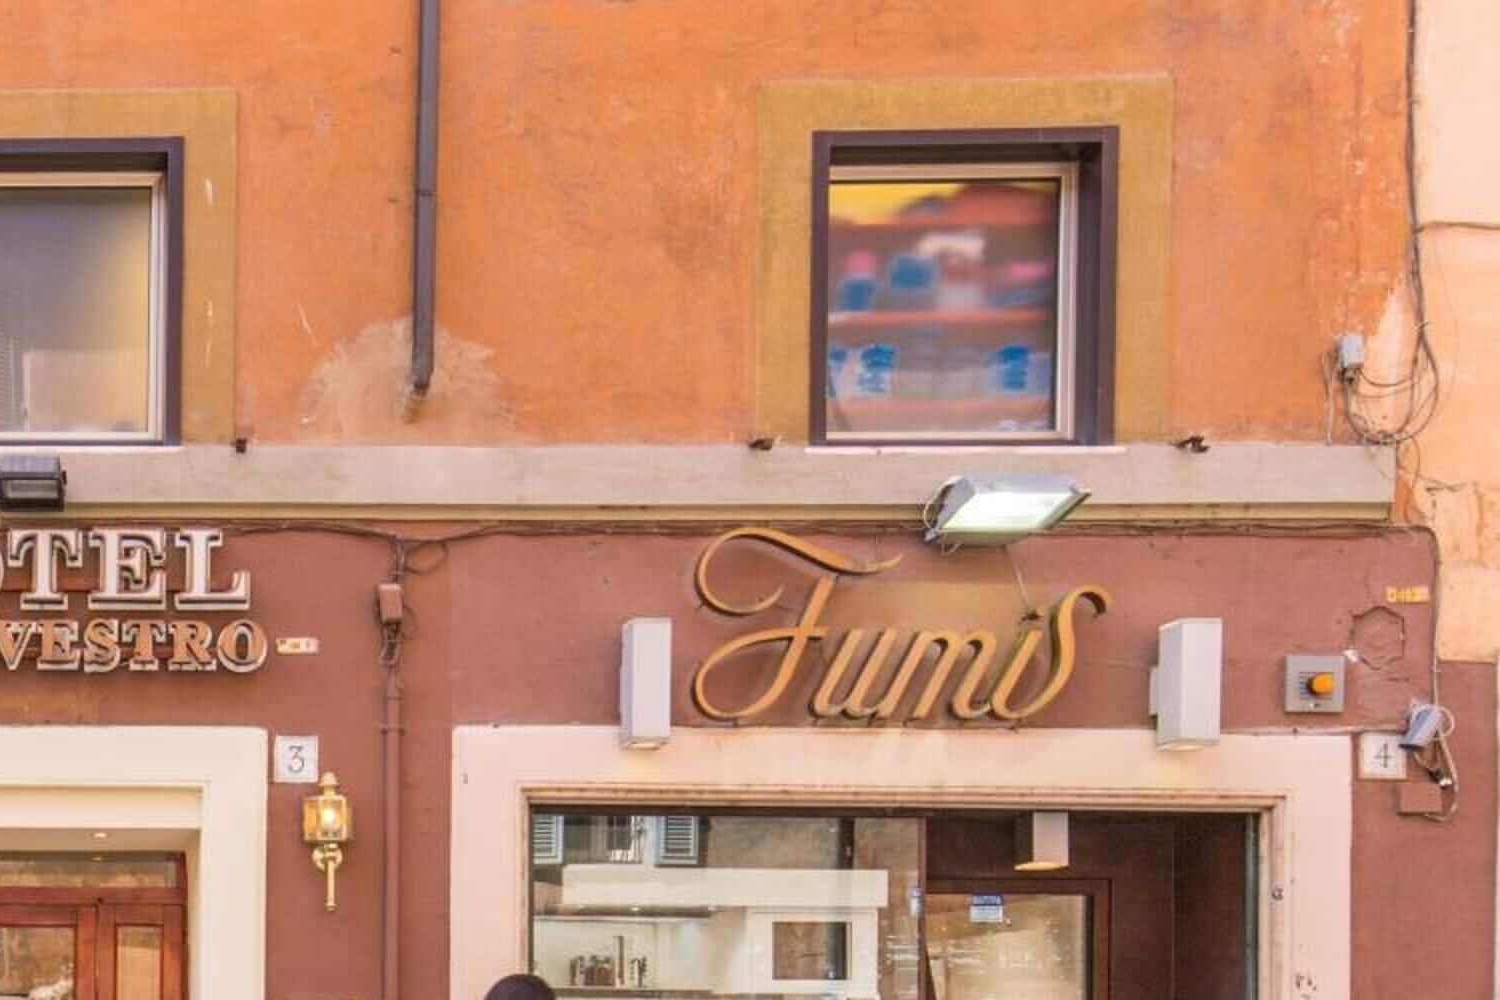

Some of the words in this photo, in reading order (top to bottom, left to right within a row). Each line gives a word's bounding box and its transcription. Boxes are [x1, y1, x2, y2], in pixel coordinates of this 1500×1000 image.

[691, 526, 1109, 724] Fumis
[287, 745, 305, 773] 3
[1374, 743, 1394, 769] 4
